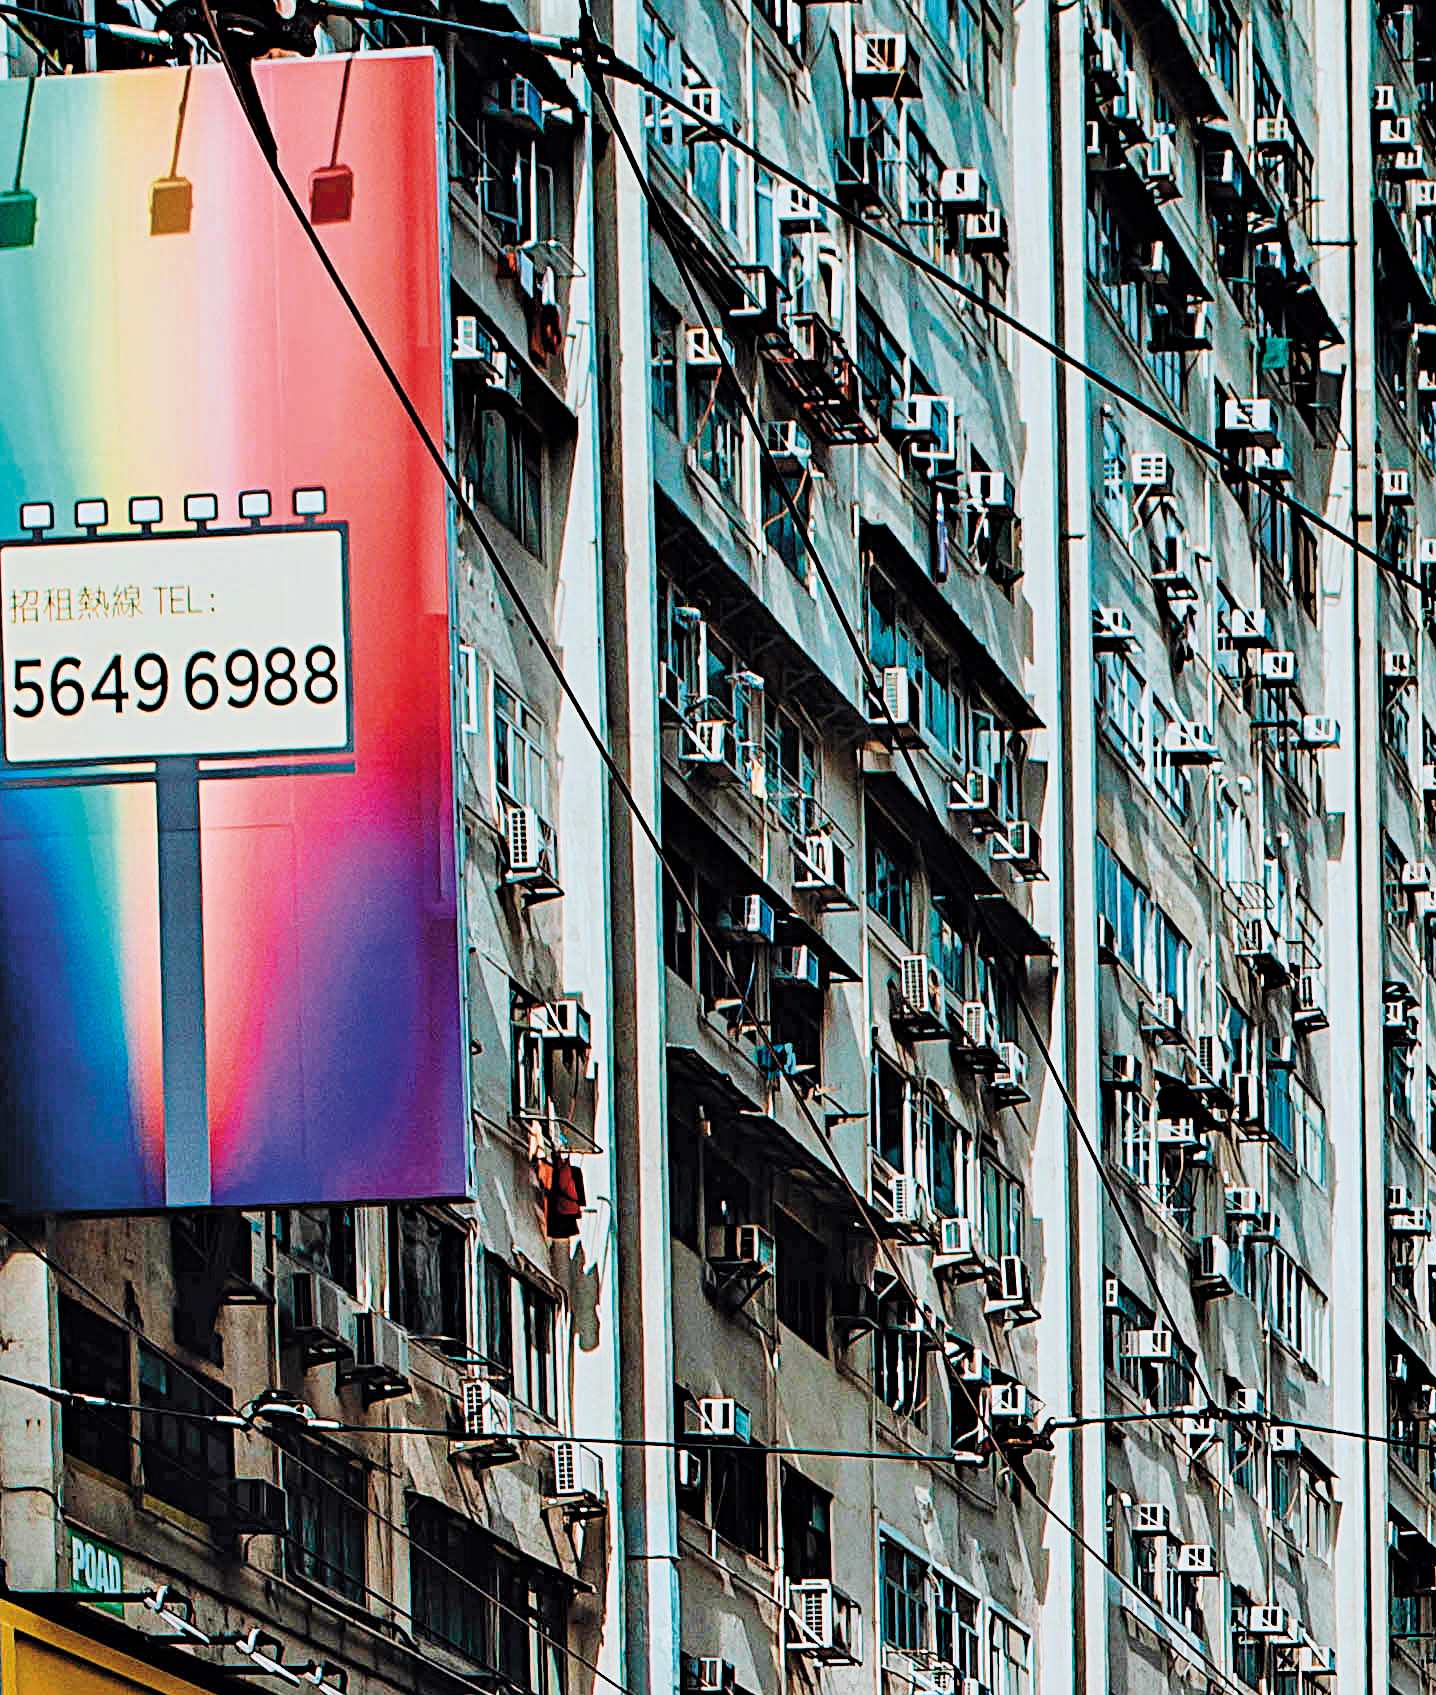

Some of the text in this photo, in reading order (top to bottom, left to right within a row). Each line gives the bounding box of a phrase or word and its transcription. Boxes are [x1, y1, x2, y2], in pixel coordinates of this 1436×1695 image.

[9, 584, 144, 624] 招租熱線
[13, 644, 338, 718] 5649 6988
